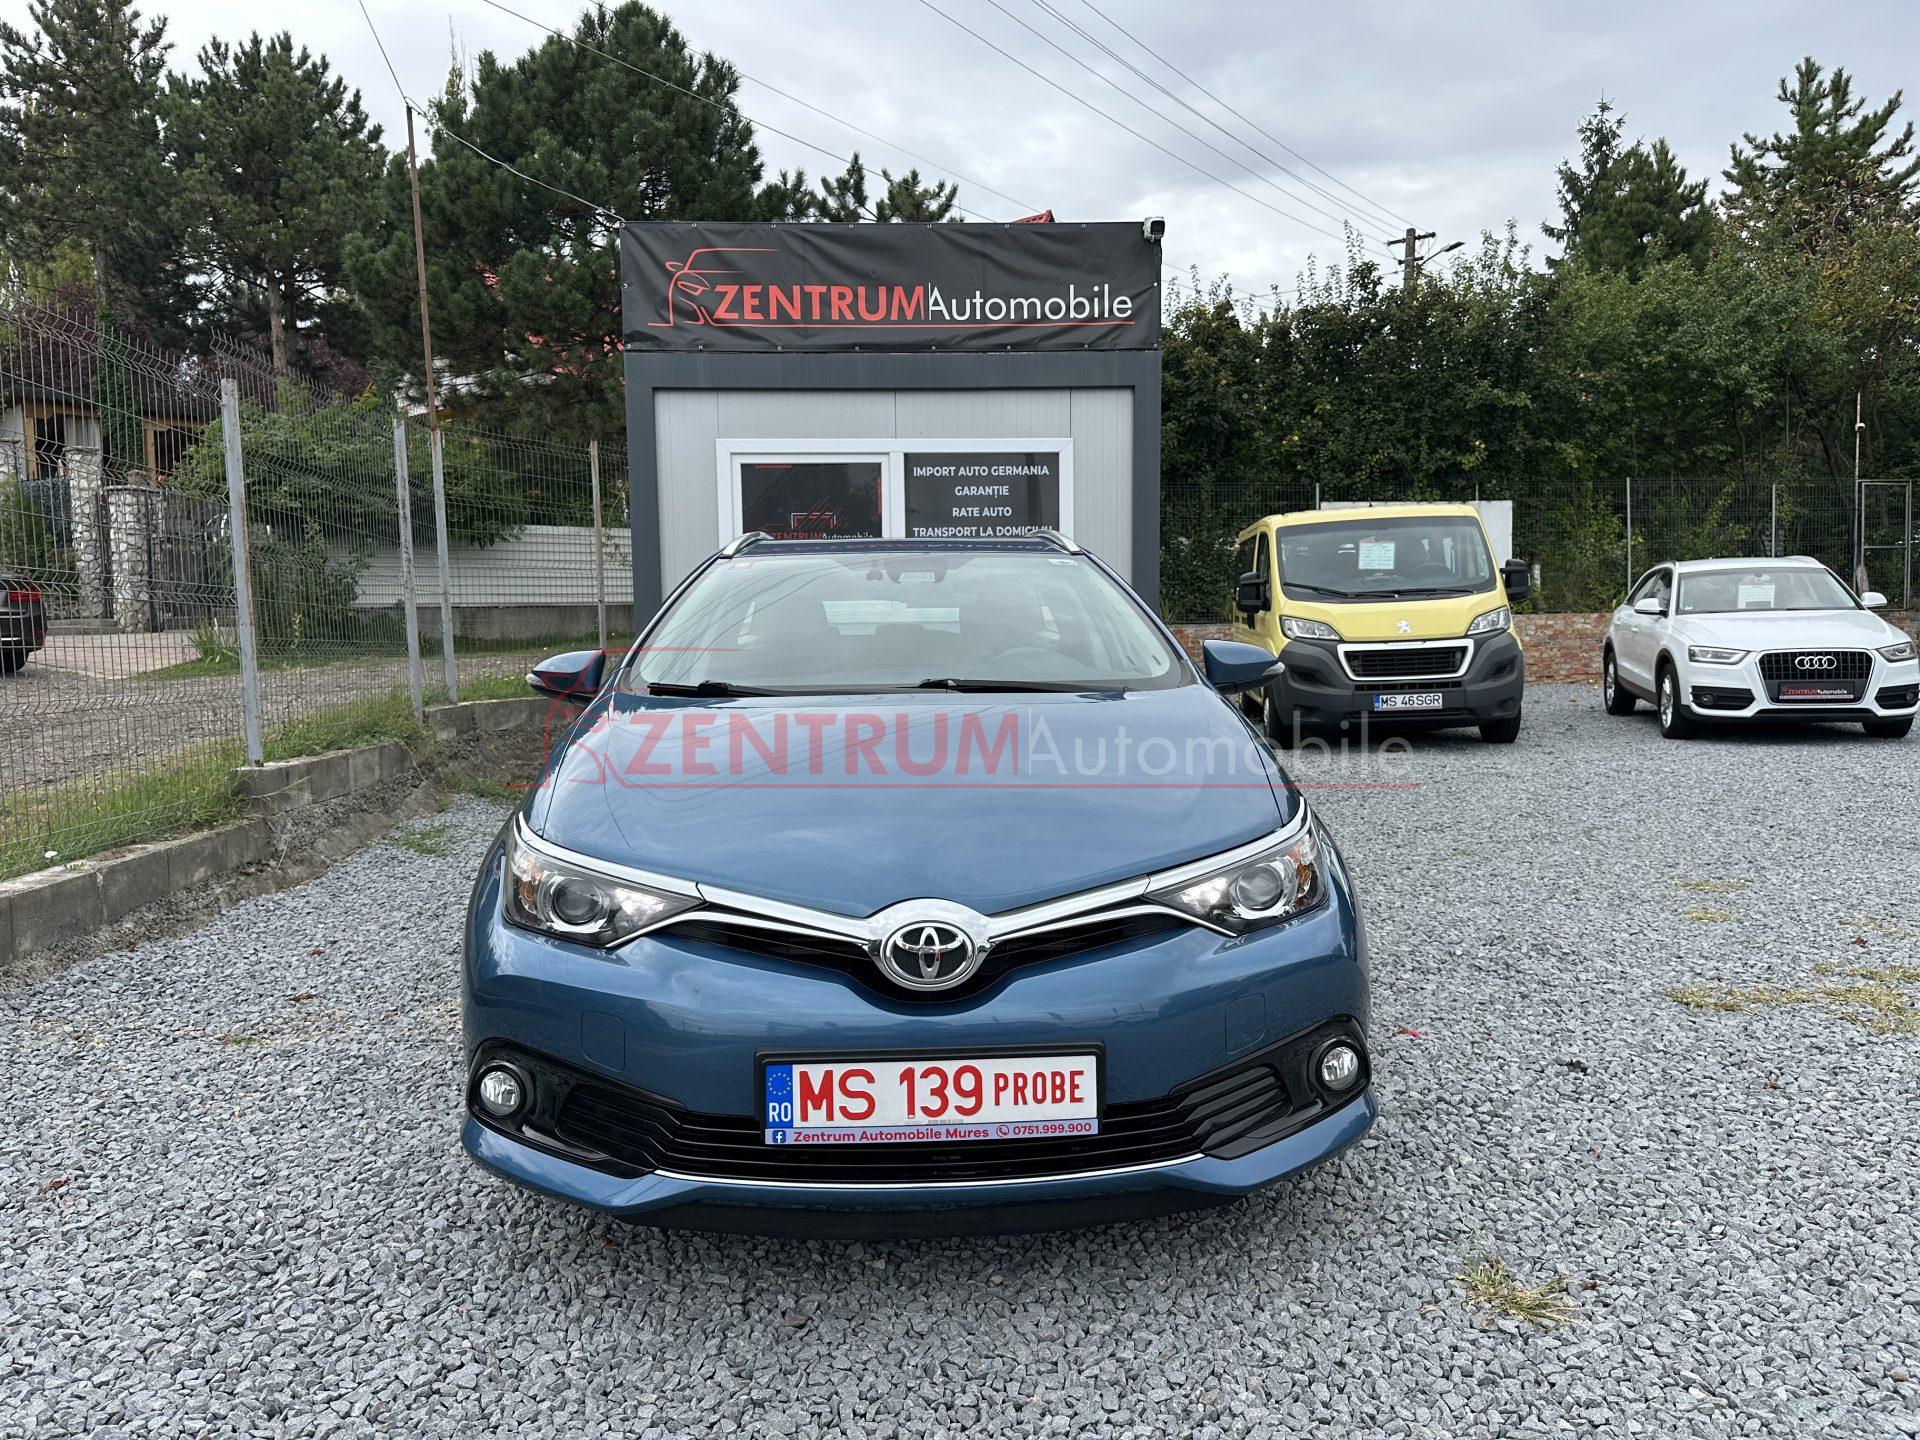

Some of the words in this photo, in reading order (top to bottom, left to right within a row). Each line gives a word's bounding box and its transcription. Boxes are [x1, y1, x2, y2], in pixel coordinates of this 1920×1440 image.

[713, 285, 924, 321] ZENTRUM
[929, 283, 1133, 320] Automobile
[913, 467, 955, 477] IMPORT
[958, 466, 988, 476] AUTO
[991, 465, 1050, 476] GERMANIA
[952, 507, 979, 517] RATE
[982, 507, 1012, 517] AUTO
[913, 527, 977, 537] TRANSPORT
[979, 526, 993, 536] LA
[1380, 694, 1397, 707] MS
[799, 1068, 875, 1122] MS
[899, 1065, 983, 1119] 139
[994, 1070, 1084, 1106] PROBE
[768, 1102, 792, 1122] RO
[794, 1131, 855, 1142] Zentrum
[859, 1128, 941, 1140] Automobile
[945, 1128, 989, 1139] Mures
[1013, 1123, 1092, 1135] 0751.999.900
